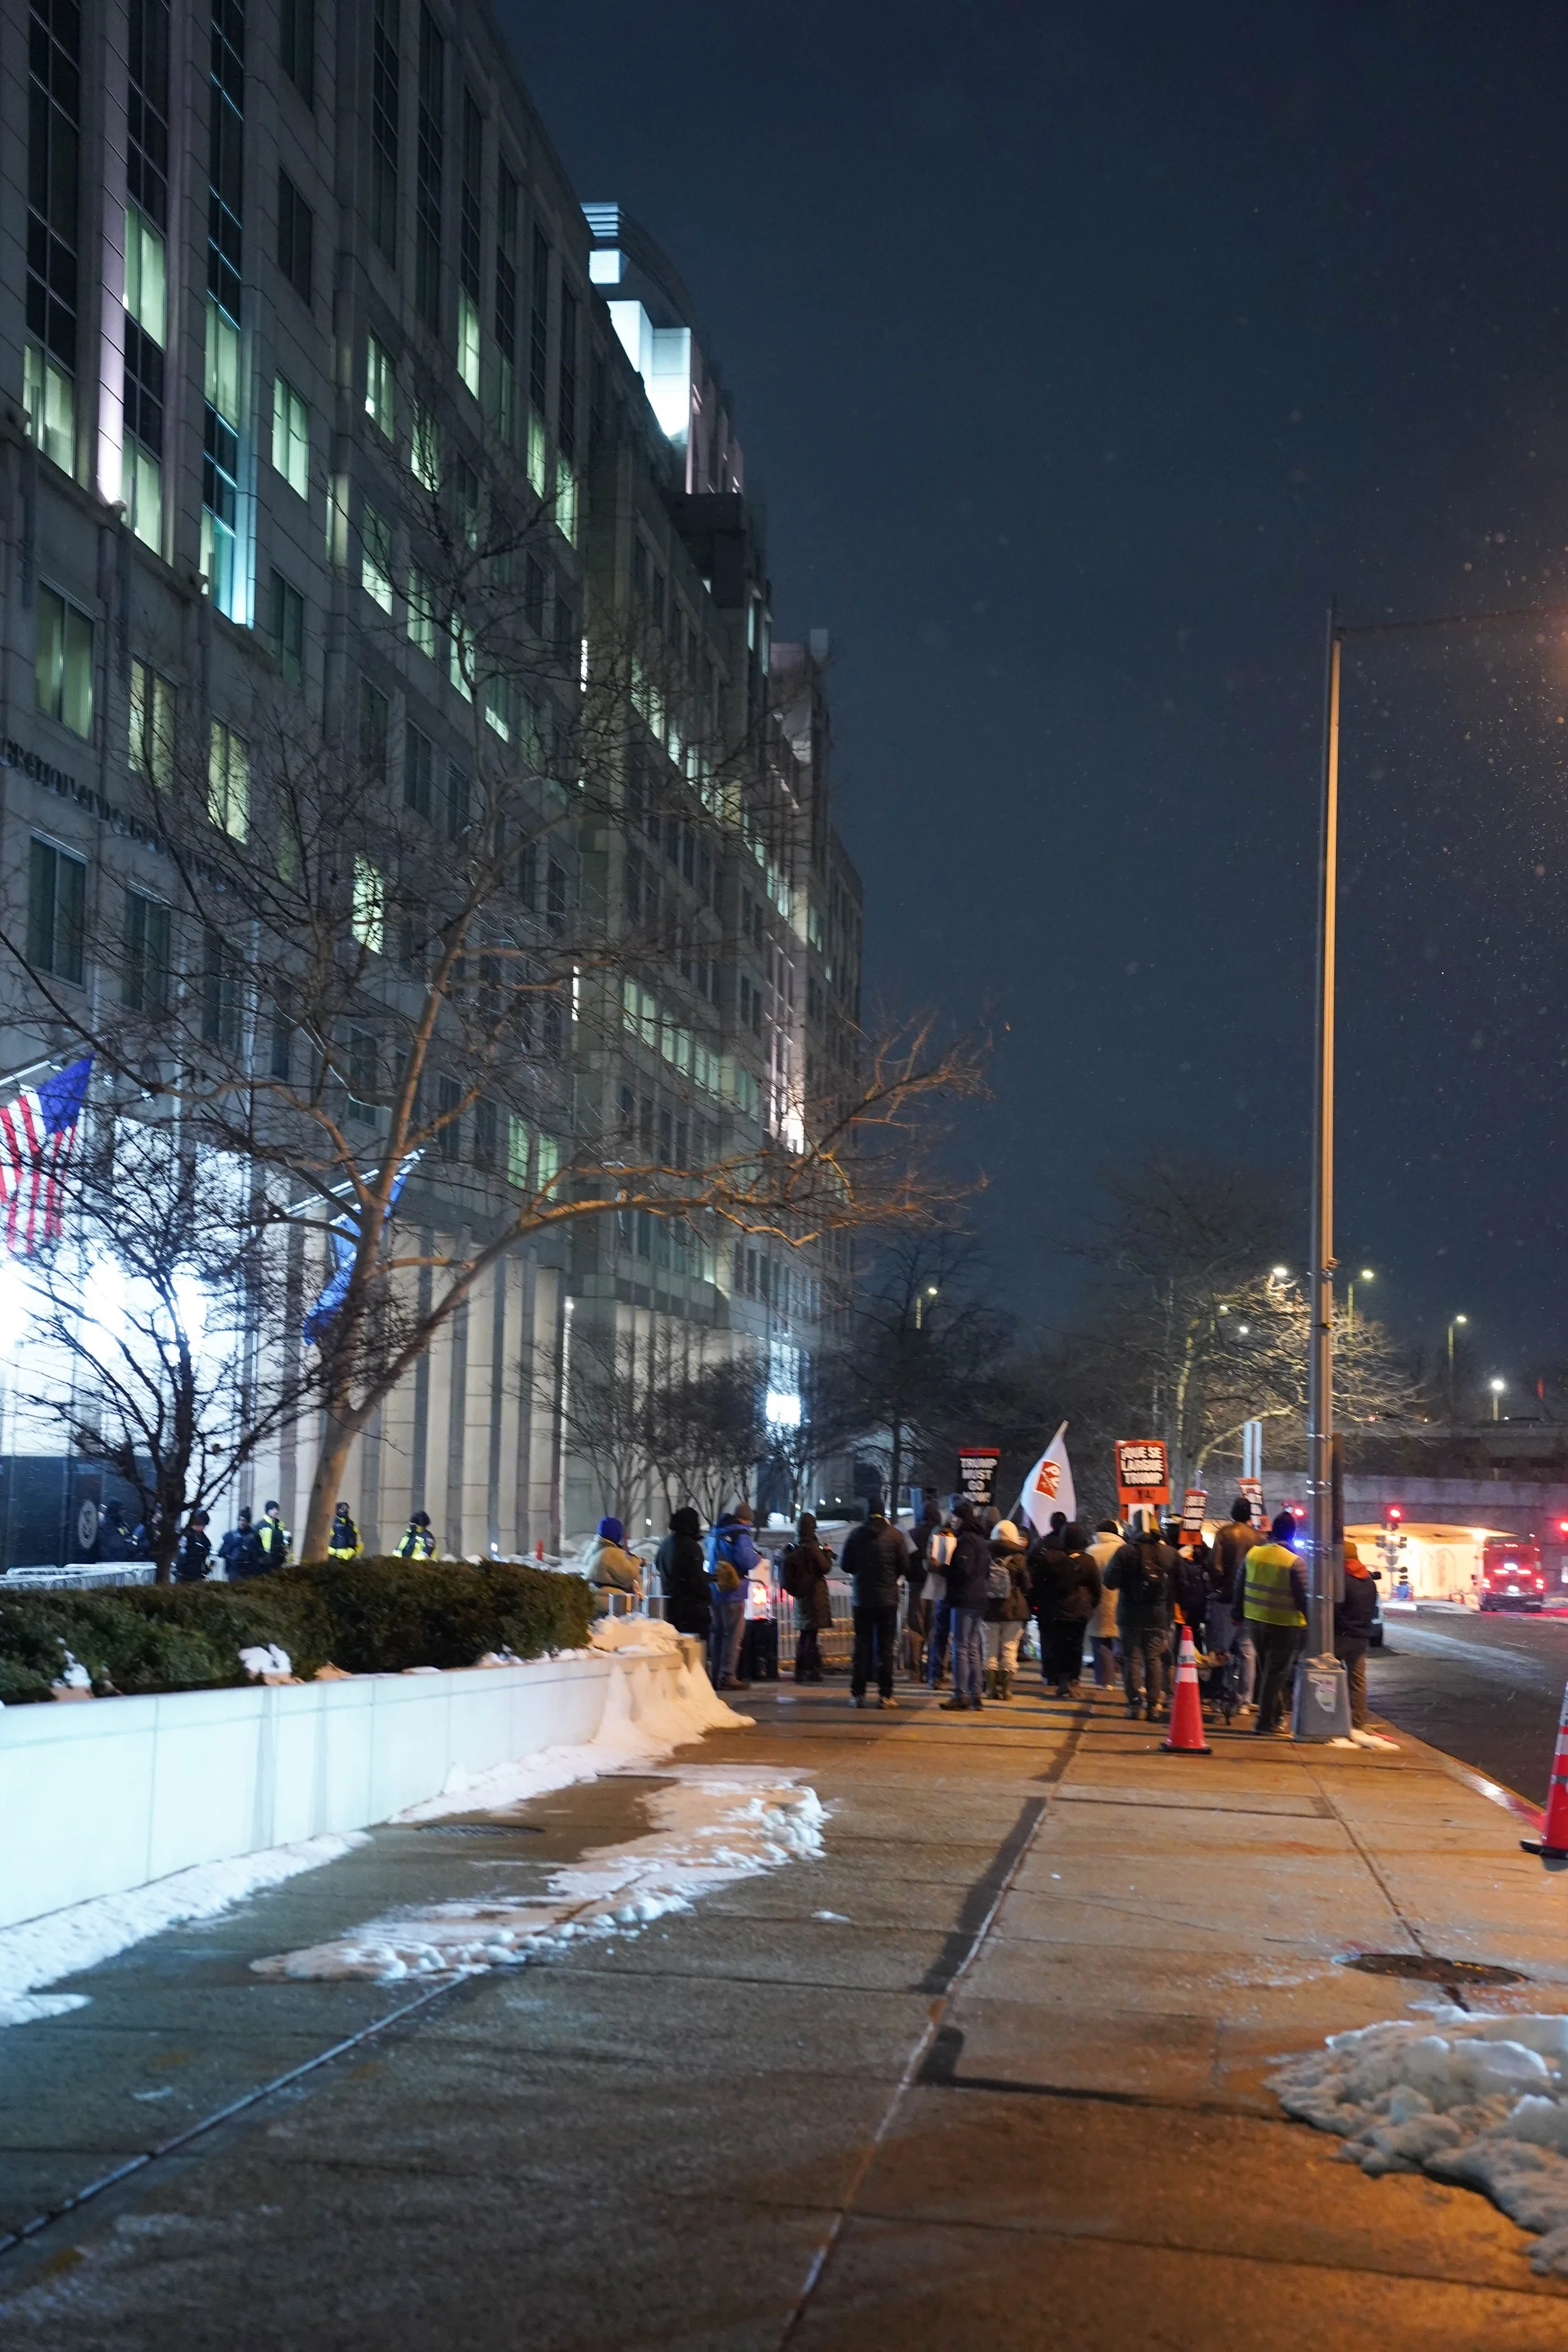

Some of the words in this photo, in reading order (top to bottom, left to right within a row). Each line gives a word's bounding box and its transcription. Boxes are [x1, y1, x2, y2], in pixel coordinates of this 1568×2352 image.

[1147, 1446, 1163, 1459] SE
[960, 1458, 997, 1469] TRUMP
[1121, 1458, 1164, 1471] LARGUE
[961, 1469, 993, 1480] MUST
[1123, 1472, 1163, 1484] TRUMP
[967, 1480, 985, 1491] GO
